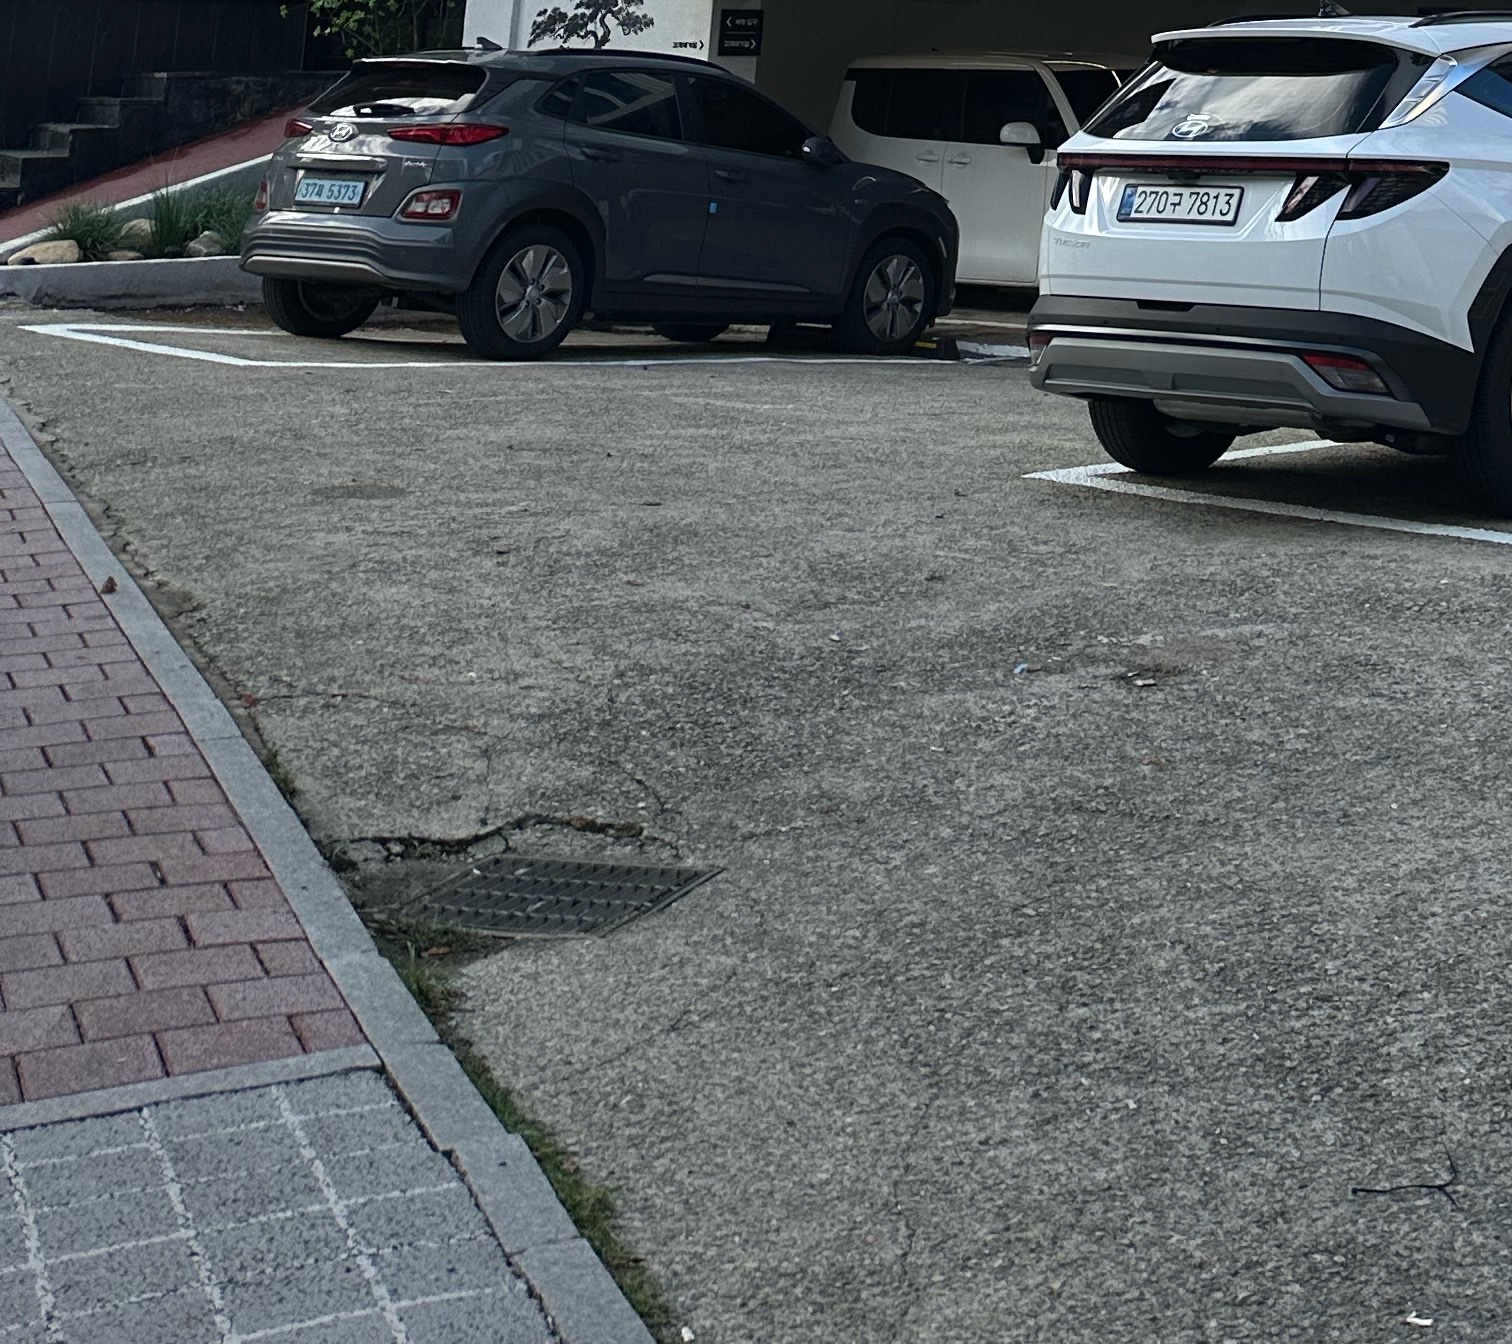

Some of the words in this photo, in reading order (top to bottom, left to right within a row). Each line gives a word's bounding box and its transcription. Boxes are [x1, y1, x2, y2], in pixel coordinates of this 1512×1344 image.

[326, 183, 358, 201] 5373
[1133, 190, 1183, 215] 270구
[1187, 191, 1236, 217] 7813
